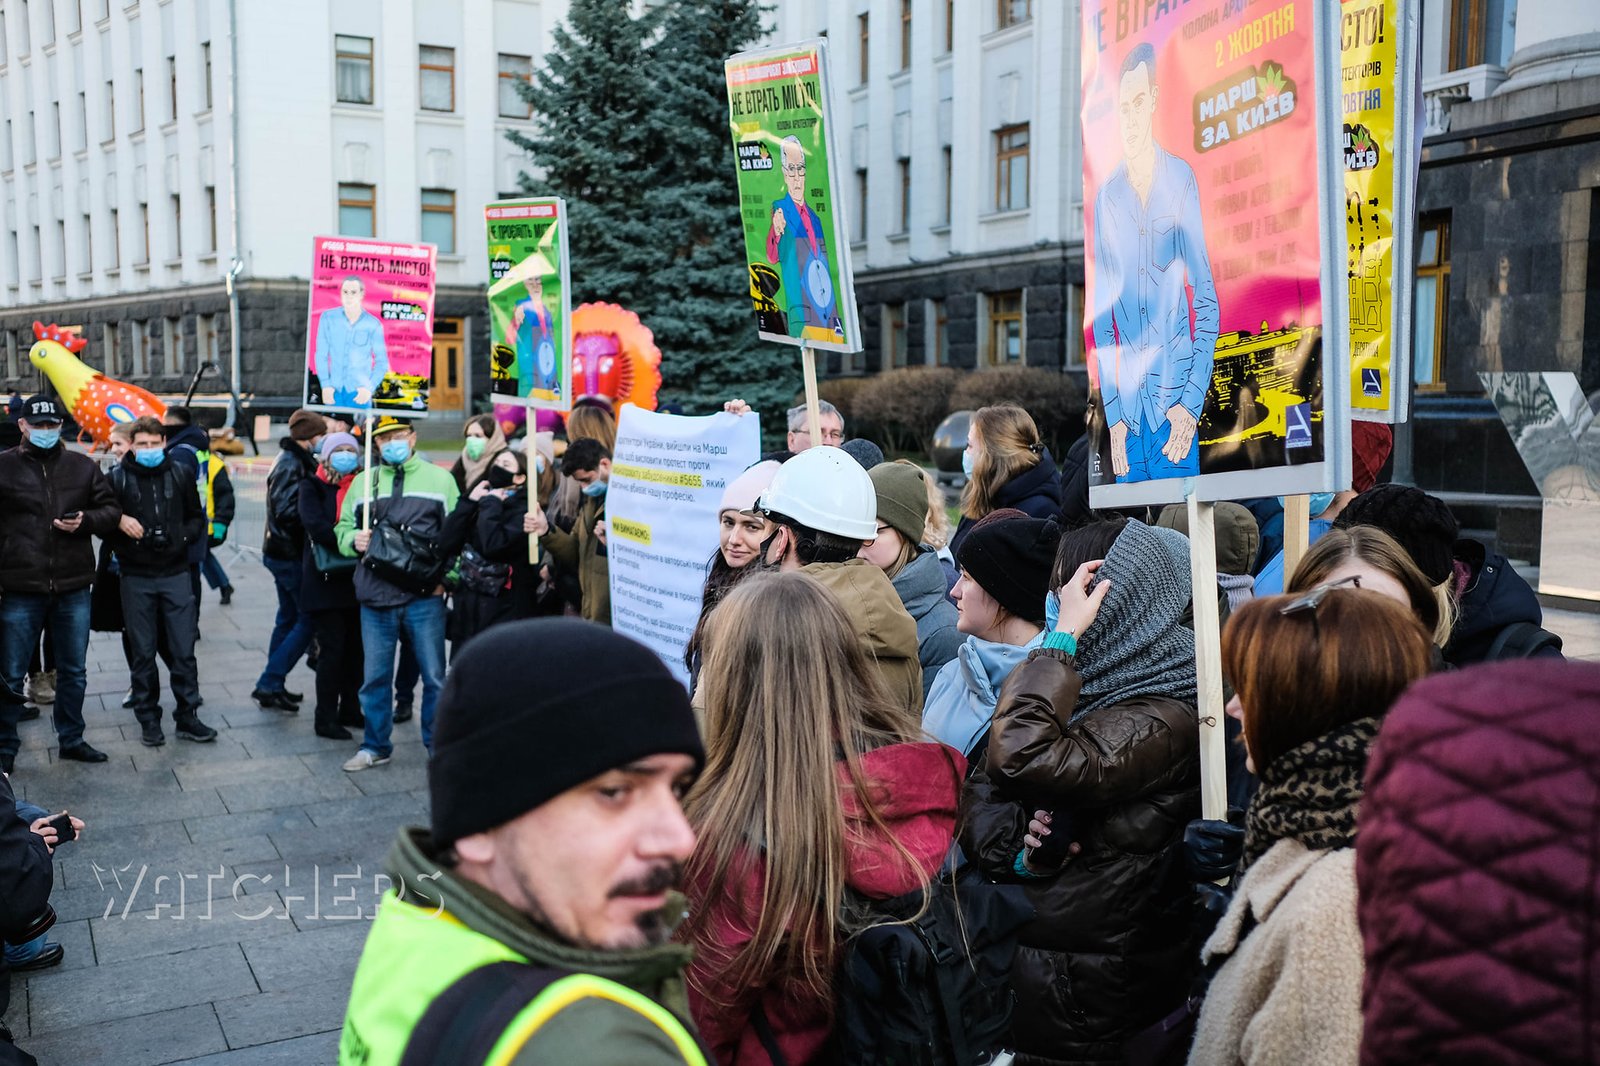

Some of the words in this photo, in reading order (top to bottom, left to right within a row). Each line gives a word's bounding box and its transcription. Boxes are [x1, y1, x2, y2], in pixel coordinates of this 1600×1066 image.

[1216, 39, 1224, 68] 2
[1228, 2, 1295, 62] ЖОВТНЯ
[1341, 4, 1384, 51] СТО!
[1342, 61, 1381, 81] ТЕКТОРІВ
[732, 92, 744, 116] НЕ
[745, 87, 780, 115] ВТРАТЬ
[1200, 76, 1257, 122] МАРШ
[1343, 88, 1381, 113] ОВТНЯ
[1201, 124, 1230, 148] ЗА
[1237, 91, 1295, 135] КИЇВ
[739, 146, 760, 157] МАРШ
[1343, 149, 1377, 168] ИЇВ
[741, 159, 752, 170] ЗА
[320, 254, 336, 269] НЕ
[340, 255, 385, 273] ВТРАТЬ
[389, 260, 430, 277] МІСТО!
[382, 303, 412, 313] МАРШ
[31, 401, 55, 415] FBI
[703, 443, 728, 456] Марш
[688, 460, 711, 471] проти
[679, 475, 704, 488] #5655,
[706, 477, 726, 489] який
